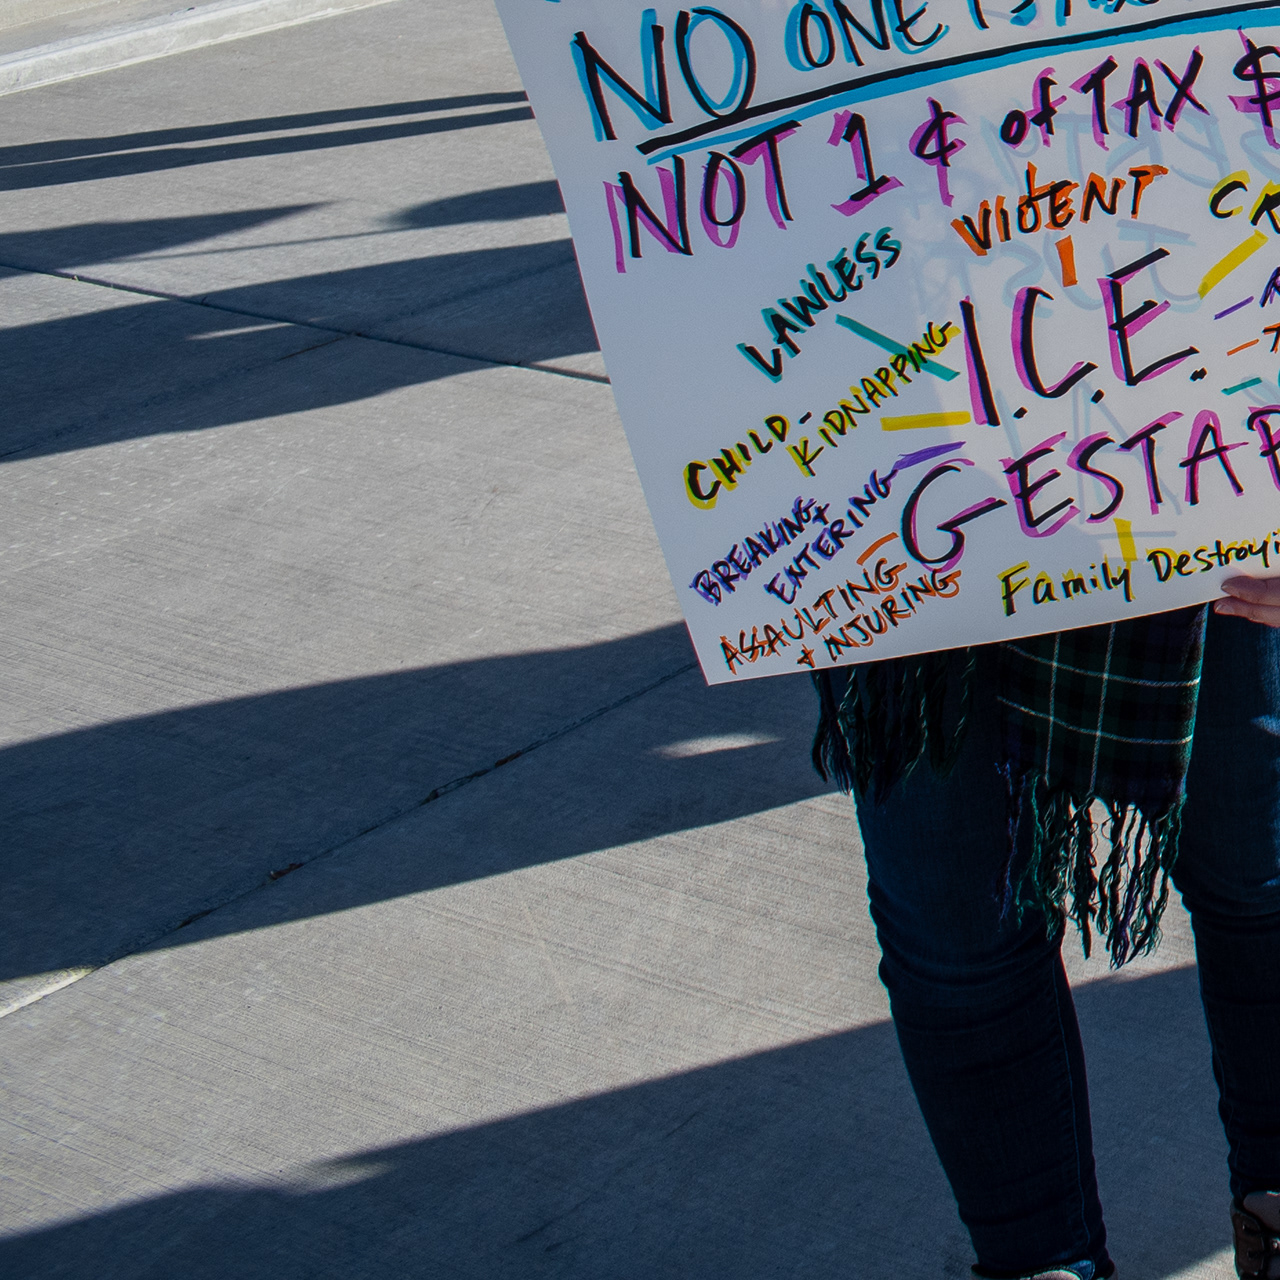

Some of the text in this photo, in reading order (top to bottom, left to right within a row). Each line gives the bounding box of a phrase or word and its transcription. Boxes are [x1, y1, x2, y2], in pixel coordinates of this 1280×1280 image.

[570, 6, 758, 141] NO
[603, 119, 803, 274] NOT
[827, 109, 905, 217] 1
[999, 66, 1069, 148] of
[1069, 43, 1211, 151] TAX
[950, 161, 1169, 257] VIOLENT
[737, 226, 904, 384] LAWLESS
[959, 247, 1207, 427] I.C.E.
[786, 320, 962, 478] KIDNAPPING
[763, 469, 899, 605] ENTERING
[997, 554, 1134, 617] Family
[719, 557, 908, 675] ASSAULTING
[822, 568, 962, 663] INJURING
